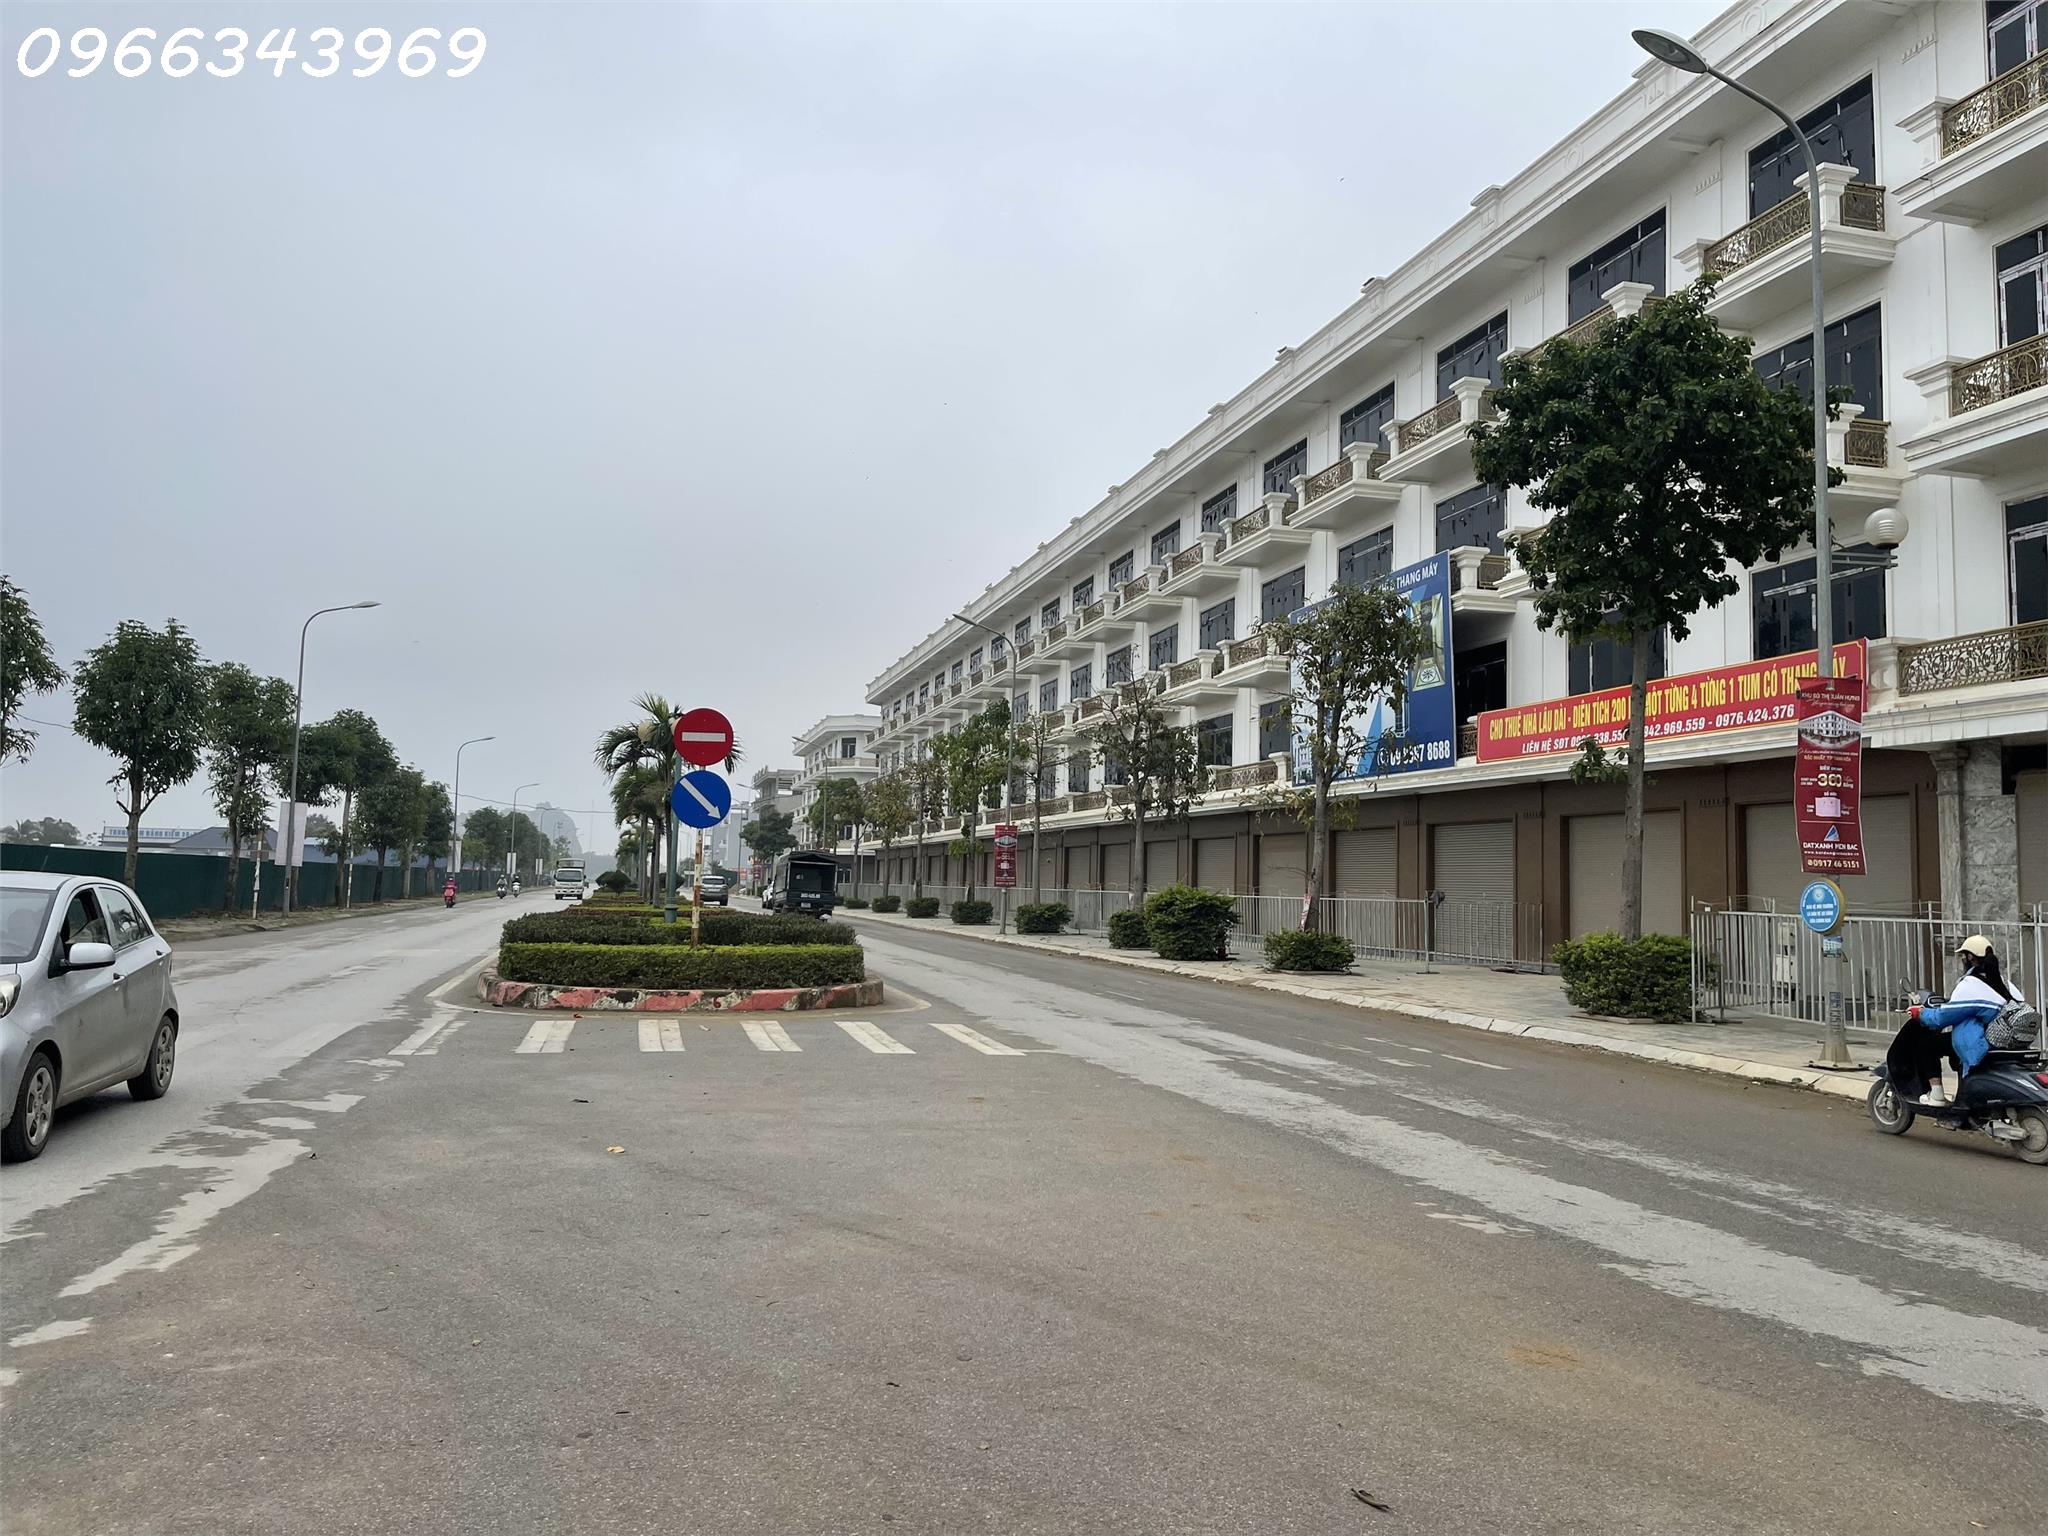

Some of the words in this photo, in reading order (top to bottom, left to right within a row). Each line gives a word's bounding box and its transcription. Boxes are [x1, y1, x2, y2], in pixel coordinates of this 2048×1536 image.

[1396, 569, 1421, 589] THANG
[1422, 562, 1438, 580] MÁY
[1489, 718, 1503, 740] CHO
[1505, 710, 1521, 738] THUÊ
[1522, 708, 1537, 736] NHÀ
[1539, 706, 1553, 734] LÂU
[1592, 696, 1609, 726] TÍCH
[1611, 696, 1626, 722] 200
[1664, 682, 1689, 713] TỪNG
[1691, 684, 1698, 709] 4
[1699, 676, 1726, 707] TỪNG
[1729, 677, 1734, 704] 1
[1738, 672, 1761, 702] TUM
[1763, 663, 1778, 698] CÓ
[1522, 740, 1540, 754] LIÊN
[1541, 738, 1552, 754] HỆ
[1553, 737, 1570, 750] SĐT
[1644, 716, 1706, 738] 942.969.559
[1715, 704, 1795, 728] 0976.424.376
[1427, 740, 1451, 761] 8688
